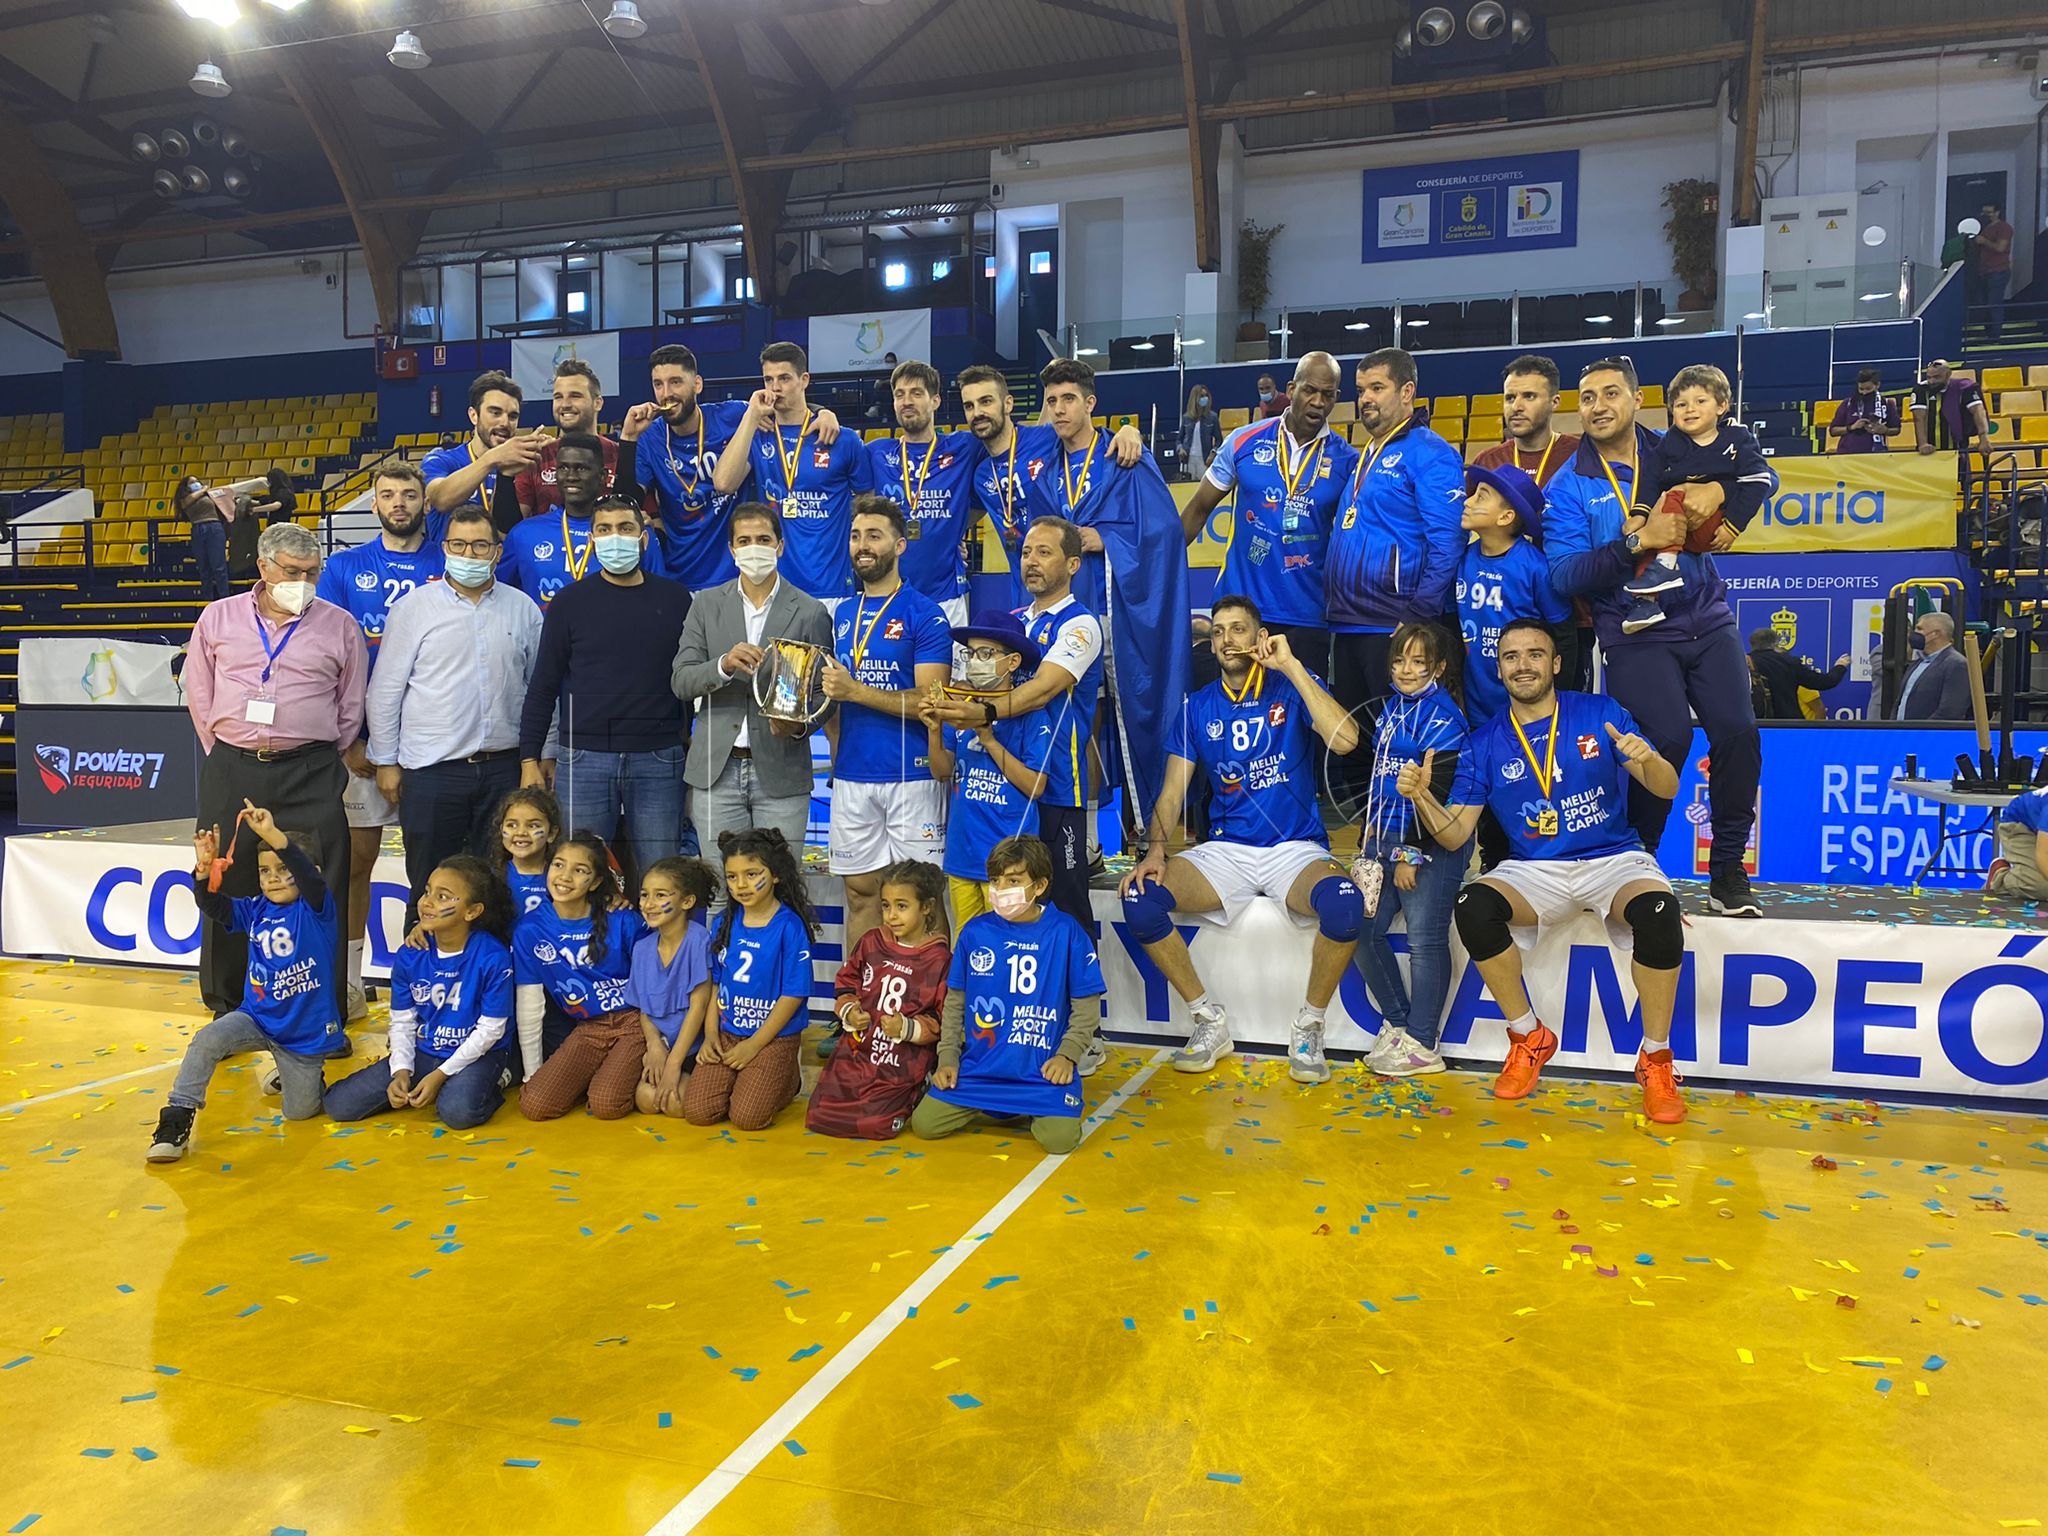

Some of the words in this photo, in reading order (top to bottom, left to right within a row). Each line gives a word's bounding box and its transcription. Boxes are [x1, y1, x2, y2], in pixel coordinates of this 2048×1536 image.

[1416, 175, 1467, 188] CONSEJERÍA
[1469, 175, 1481, 183] DE
[1482, 170, 1524, 182] DEPORTES
[1445, 231, 1463, 239] Gran
[1463, 229, 1491, 238] Canaria
[1449, 224, 1476, 233] Cabildo
[689, 451, 718, 482] 10
[796, 501, 821, 510] PORT
[918, 500, 945, 509] PORT
[796, 509, 829, 519] APITAL
[909, 510, 952, 520] CAPITAL
[1721, 576, 1780, 590] SEJERÍA
[1784, 578, 1803, 589] DE
[1806, 576, 1879, 589] DEPORTES
[1471, 582, 1503, 612] 94
[859, 659, 900, 672] MELILLA
[855, 671, 891, 682] SPORT
[1231, 716, 1265, 752] 87
[74, 748, 145, 777] POWER
[146, 753, 165, 789] 7
[72, 774, 143, 790] SEGURIDAD
[967, 778, 1002, 794] SPORT
[1822, 764, 1940, 817] REAL
[964, 789, 1009, 805] CAPITAL
[1560, 785, 1605, 810] MELILLA
[257, 926, 294, 959] 18
[733, 950, 753, 984] 2
[1006, 954, 1038, 995] 18
[271, 969, 311, 991] SPORT
[272, 978, 321, 1001] CAPITAL
[431, 981, 463, 1011] 64
[876, 974, 907, 1015] 18
[733, 1007, 770, 1019] SPORT
[1012, 1005, 1057, 1022] MELILLA
[1339, 932, 2048, 1086] CAMPEÓ
[1011, 1019, 1048, 1033] SPORT
[1007, 1031, 1052, 1050] CAPITAL
